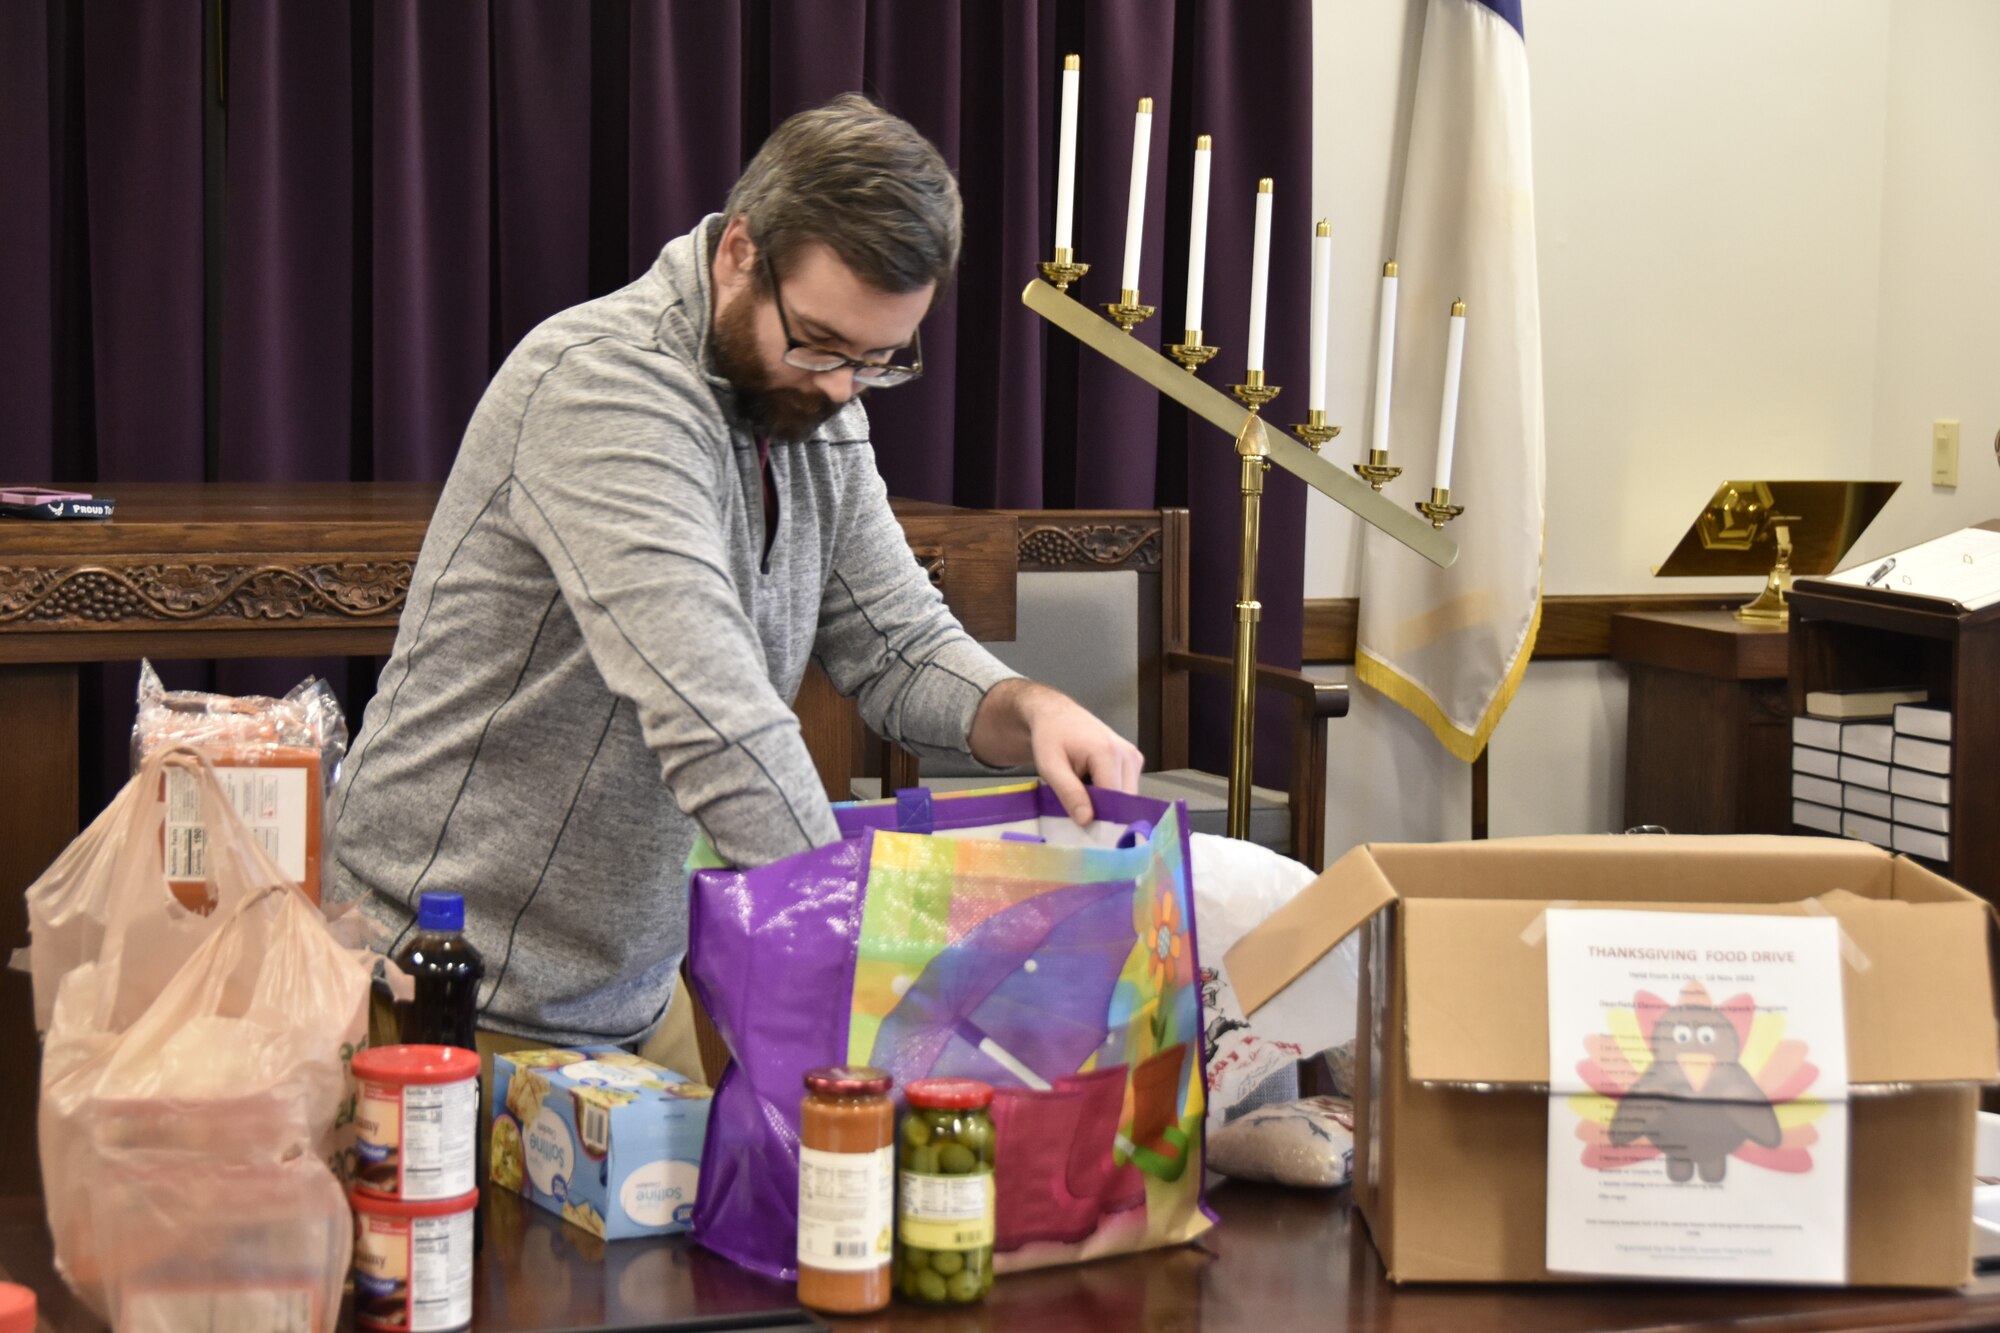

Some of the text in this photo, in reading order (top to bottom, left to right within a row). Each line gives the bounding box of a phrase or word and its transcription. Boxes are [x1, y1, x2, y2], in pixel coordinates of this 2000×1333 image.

[72, 504, 103, 514] PROUD
[1588, 946, 1796, 964] THANKSGIVING FOOD DRIVE
[530, 1134, 566, 1170] Saltine
[636, 1187, 682, 1202] Saltine
